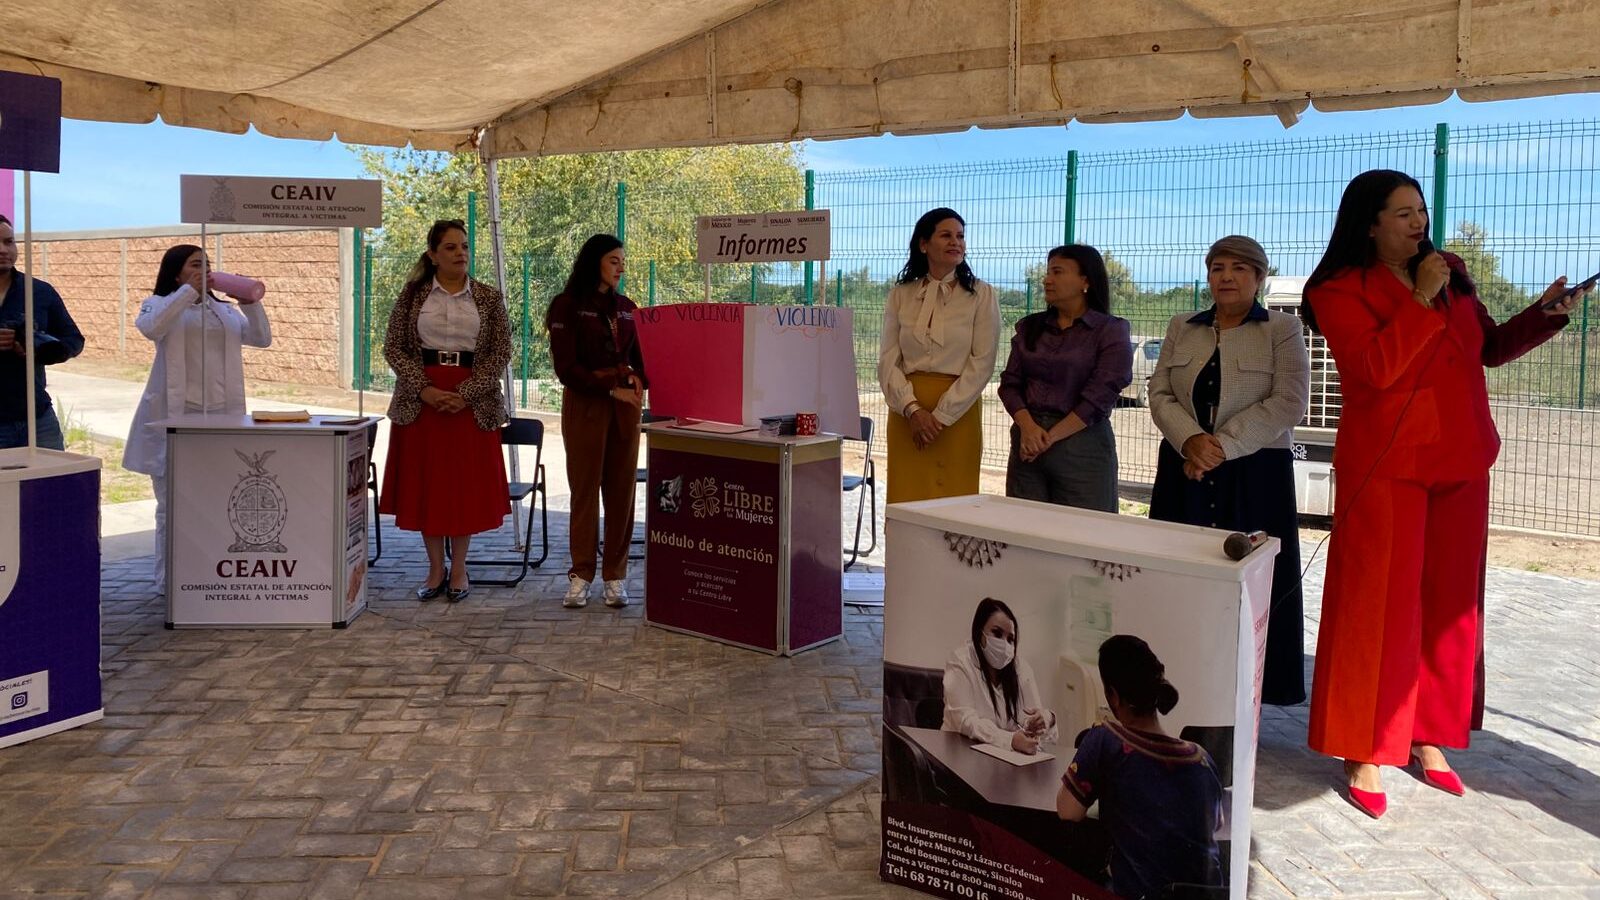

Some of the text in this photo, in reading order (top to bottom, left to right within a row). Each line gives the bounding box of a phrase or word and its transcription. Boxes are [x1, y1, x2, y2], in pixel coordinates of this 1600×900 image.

[270, 185, 336, 200] CEAIV
[717, 233, 808, 262] Informes
[640, 308, 661, 324] NO
[675, 304, 740, 323] VIOLENCIA
[776, 307, 840, 328] VIOLENCIA
[724, 482, 744, 491] Centro
[724, 490, 774, 513] LIBRE
[736, 508, 774, 525] Mujeres
[651, 530, 773, 564] Módulo de atención
[216, 560, 298, 578] CEAIV
[684, 568, 703, 578] Conoce
[713, 575, 736, 585] servicios
[180, 583, 227, 591] COMISIÓN
[286, 583, 332, 591] ATENCIÓN
[700, 589, 717, 598] Centro
[718, 592, 732, 602] Libre
[0, 678, 32, 691] OCIALES!
[887, 816, 975, 849] Blvd. Insurgentes #61,
[887, 830, 1044, 883] entre López Mateos y Lázaro Cárdenas
[887, 840, 1022, 888] Col. del Bosque, Guasave, Sinaloa
[886, 862, 989, 900] Tel: 68 78 71 00 16
[887, 851, 910, 865] Lunes
[917, 860, 949, 876] Viernes
[950, 870, 961, 879] de
[962, 874, 982, 886] 8:00
[983, 881, 996, 891] am
[1004, 888, 1024, 900] 3:00
